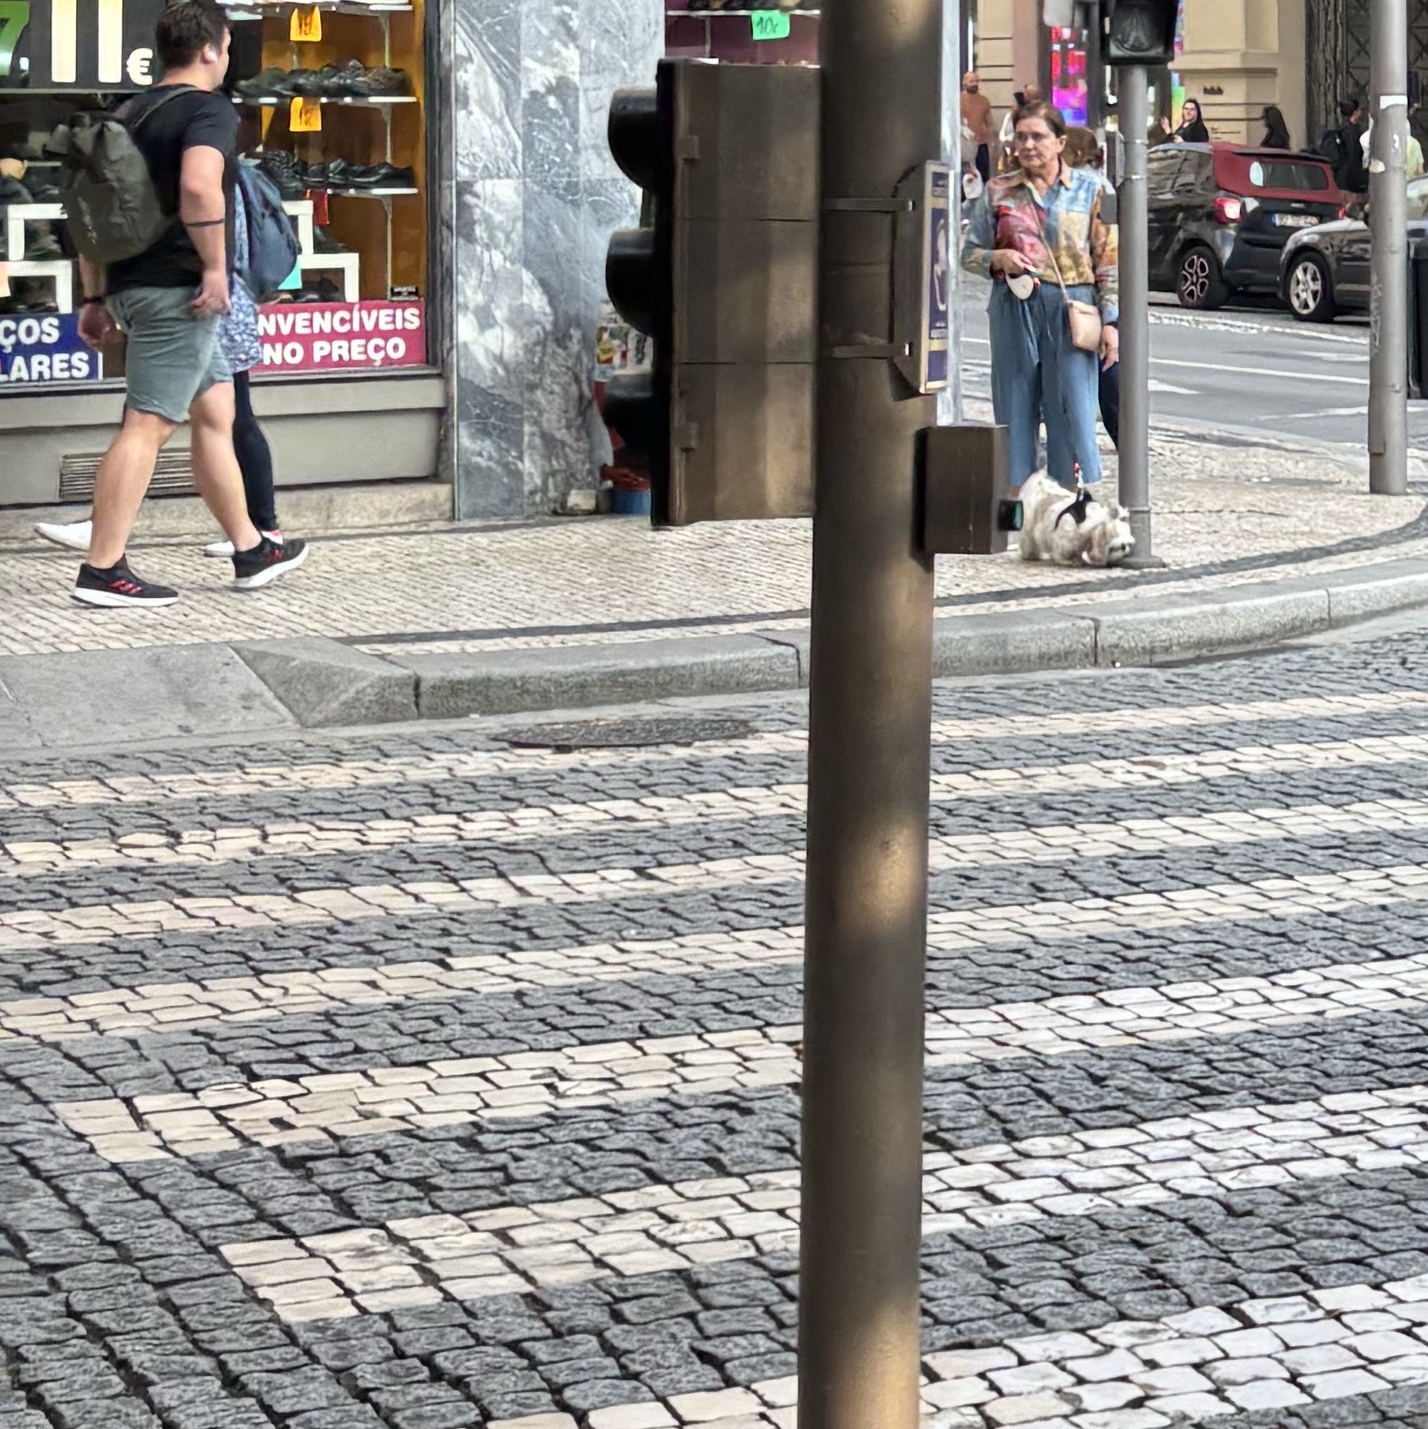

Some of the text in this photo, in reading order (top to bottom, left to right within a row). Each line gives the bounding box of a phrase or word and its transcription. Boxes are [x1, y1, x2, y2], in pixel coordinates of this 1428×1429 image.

[258, 304, 421, 336] NVENCÍVEIS
[263, 337, 406, 366] NO PREÇO
